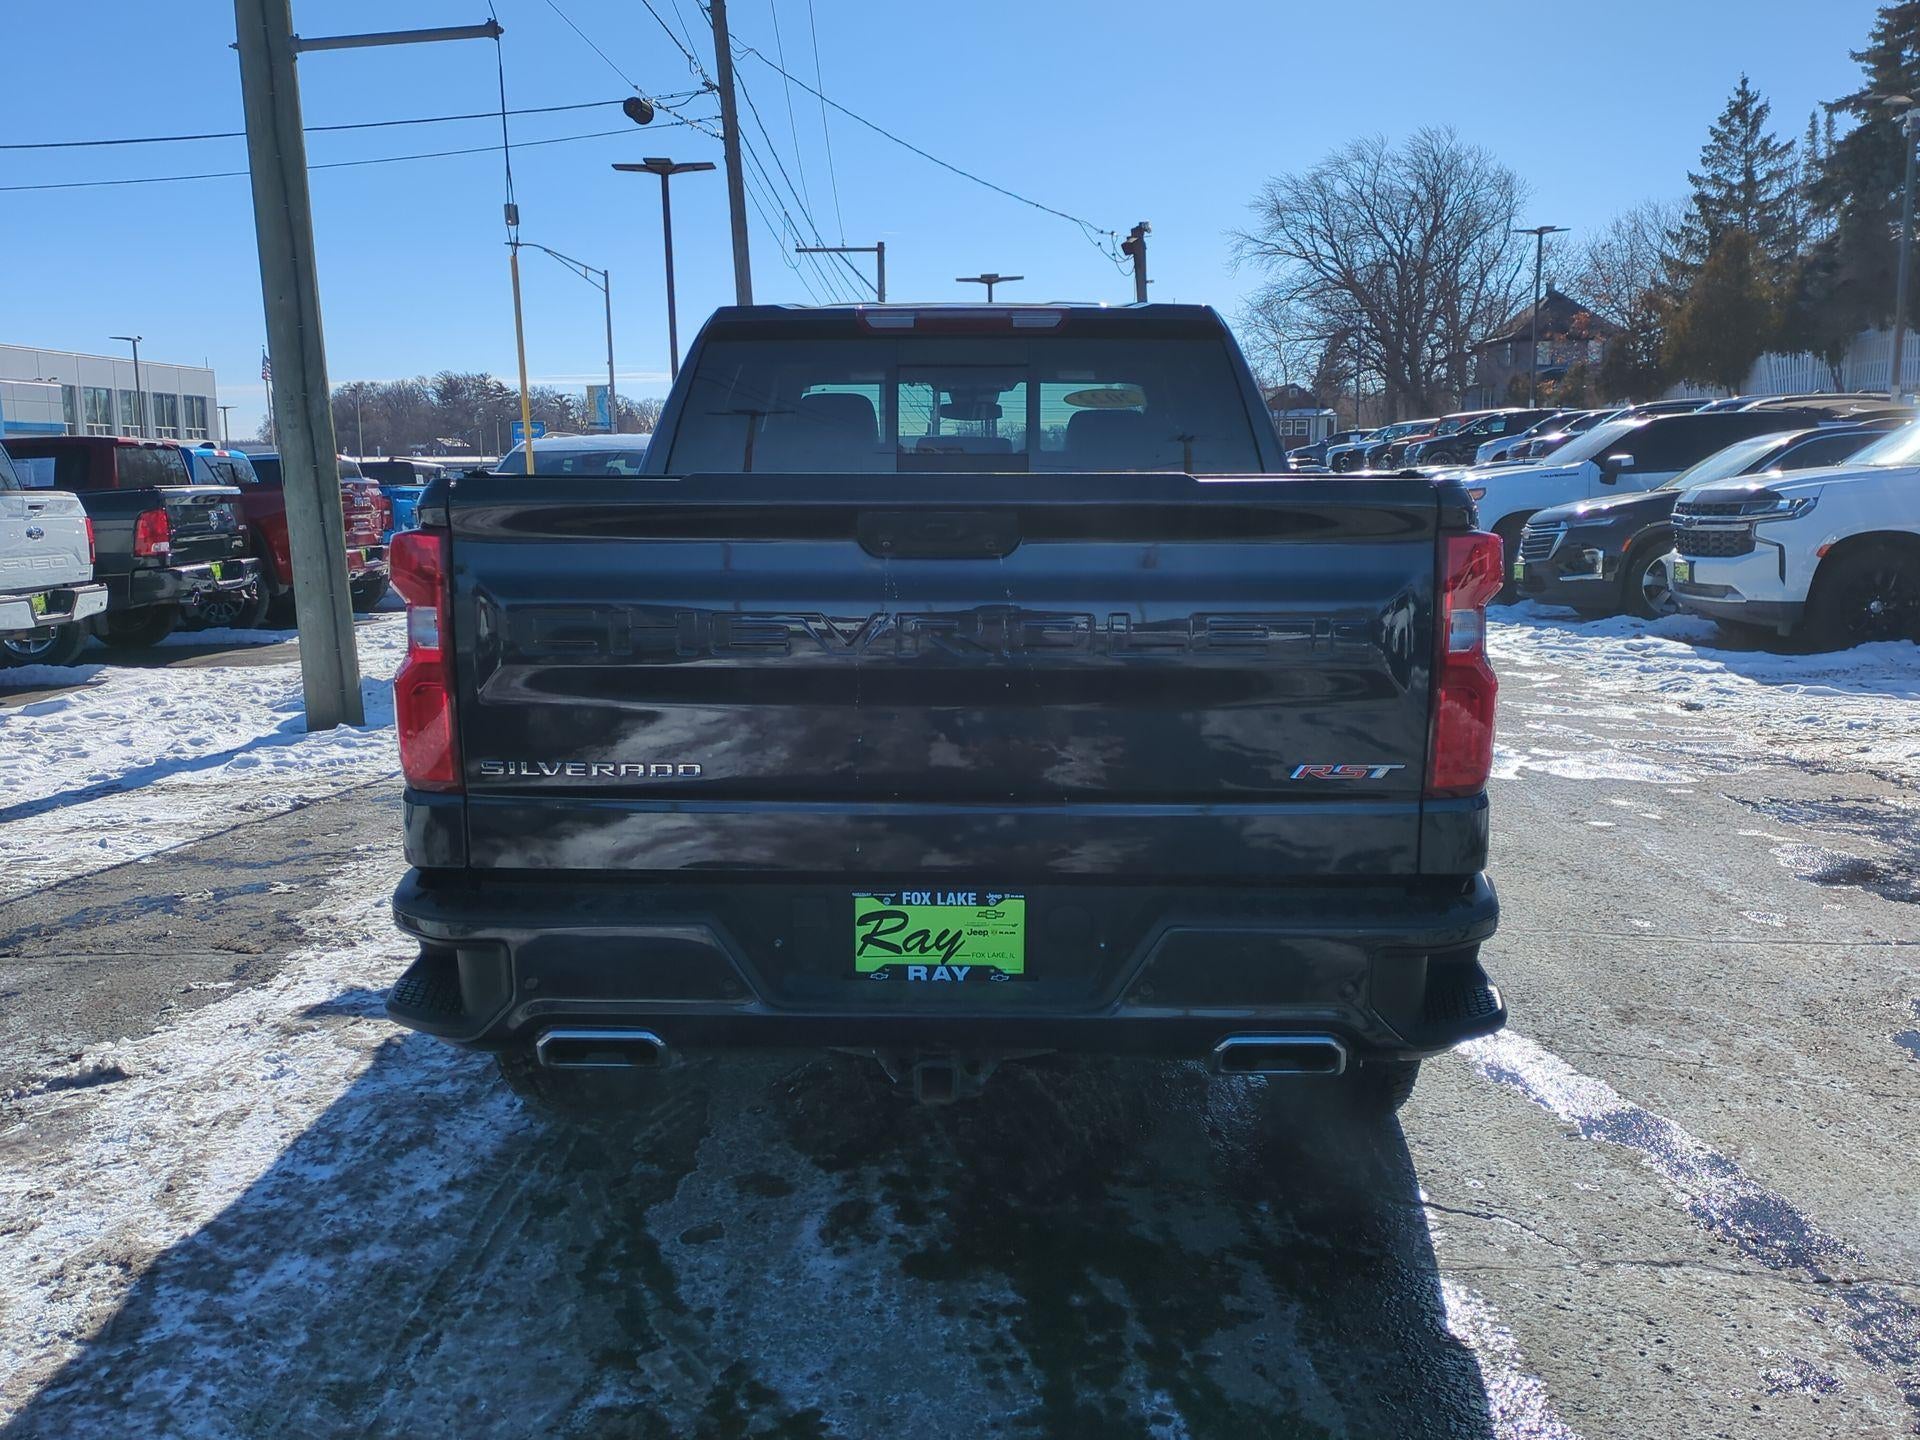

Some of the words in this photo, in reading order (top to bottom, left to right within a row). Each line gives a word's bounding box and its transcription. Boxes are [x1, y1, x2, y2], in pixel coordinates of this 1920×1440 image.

[480, 761, 701, 777] SILVERADO
[1290, 764, 1406, 779] RST
[902, 892, 931, 905] FOX
[937, 892, 977, 906] LAKE
[857, 909, 966, 965] Ray
[967, 928, 989, 937] Jeep
[908, 966, 970, 981] RAY
